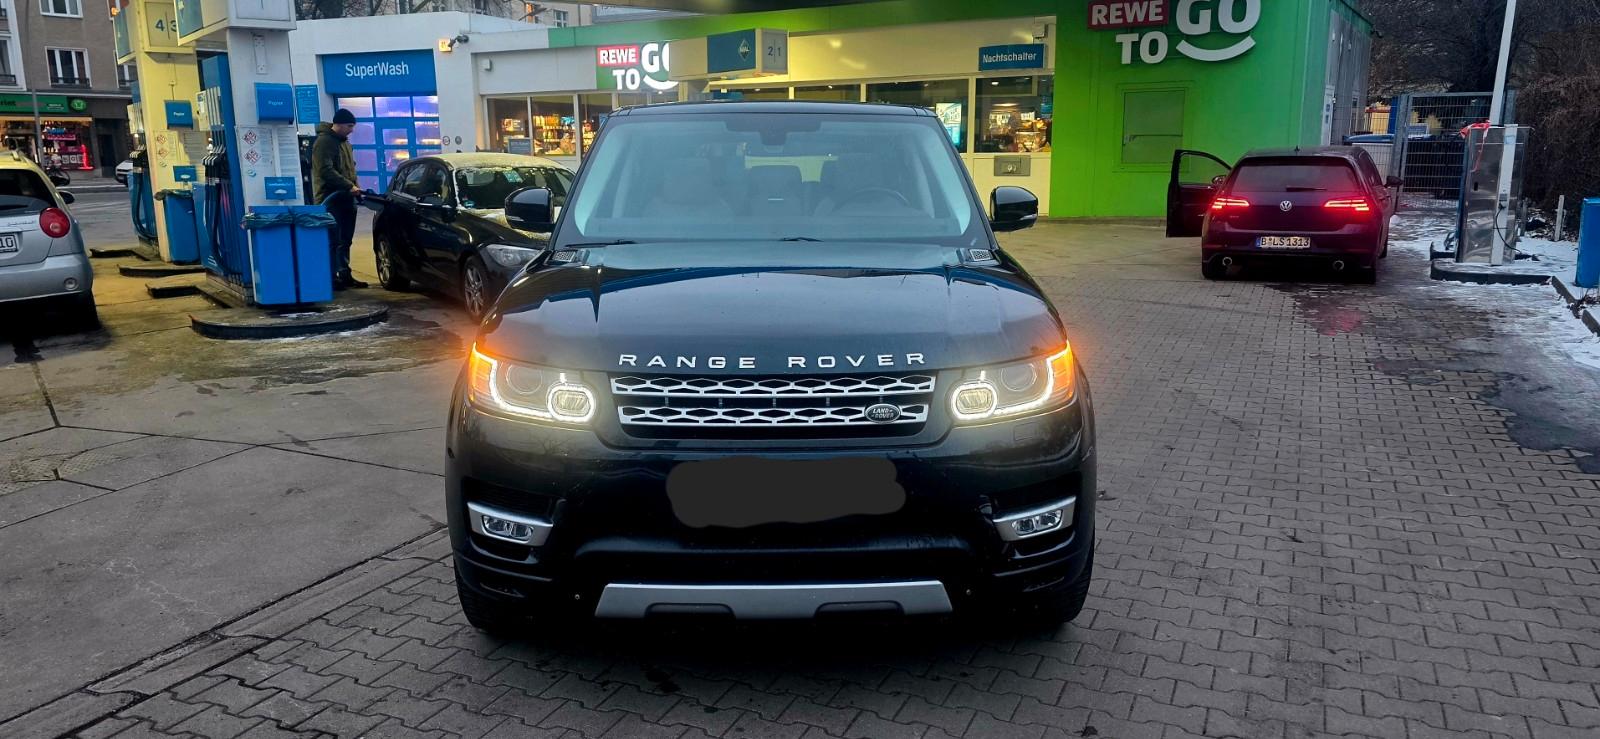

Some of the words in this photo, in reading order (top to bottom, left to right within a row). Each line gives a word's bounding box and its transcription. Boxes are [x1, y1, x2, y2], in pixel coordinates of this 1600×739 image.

[1092, 1, 1163, 25] REWE
[1176, 0, 1261, 35] GO
[155, 20, 165, 31] 4
[600, 48, 636, 64] REWE
[767, 46, 774, 56] 2
[1116, 31, 1169, 65] TO
[982, 53, 1036, 63] Nachtschalter
[345, 61, 409, 79] SuperWash
[613, 68, 640, 90] TO
[618, 354, 756, 369] RANGE
[787, 353, 925, 368] ROVER
